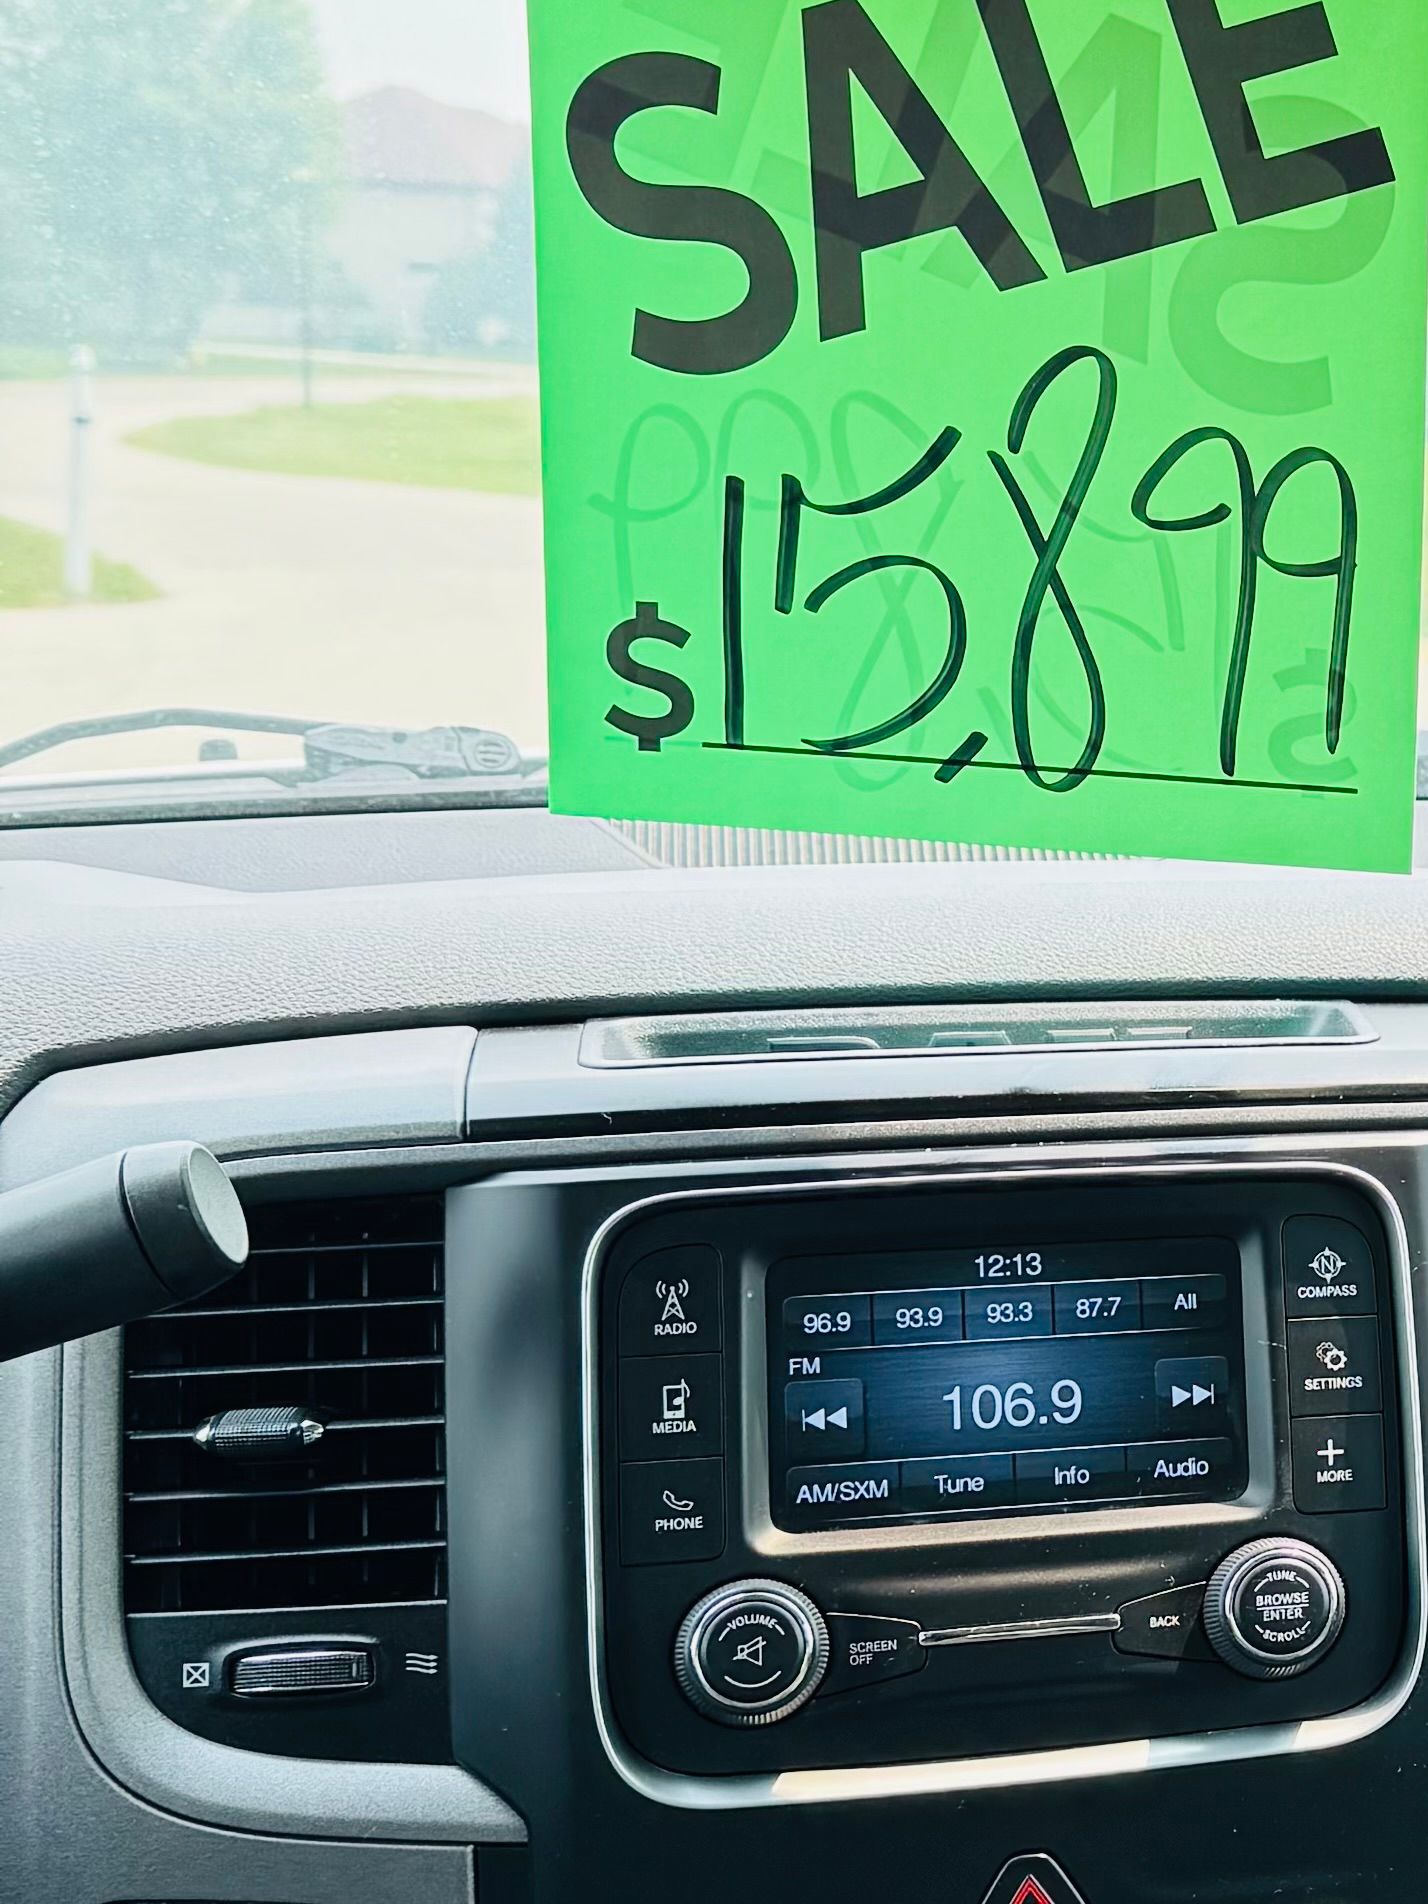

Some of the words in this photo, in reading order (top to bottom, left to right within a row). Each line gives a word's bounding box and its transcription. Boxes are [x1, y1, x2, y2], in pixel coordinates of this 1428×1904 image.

[604, 345, 1358, 793] $15,899
[975, 1253, 1041, 1277] 12:13
[1298, 1285, 1357, 1298] COMPASS
[1076, 1297, 1121, 1318] 87.7
[1175, 1293, 1197, 1310] All
[896, 1307, 942, 1328] 93.9
[987, 1302, 1032, 1323] 93.3
[655, 1322, 697, 1335] RADIO
[804, 1312, 850, 1333] 96.9
[789, 1357, 820, 1375] FM
[1305, 1376, 1362, 1390] SETTINGS
[943, 1380, 1081, 1429] 106.9
[653, 1420, 696, 1433] MEDIA
[1055, 1466, 1089, 1485] Info
[1154, 1458, 1208, 1478] Audio
[1317, 1469, 1353, 1482] MORE
[796, 1480, 888, 1503] AM/SXM
[934, 1475, 984, 1493] Tune
[655, 1516, 703, 1531] PHONE
[1266, 1570, 1297, 1582] TUNE
[1256, 1591, 1309, 1607] BROWSE
[727, 1614, 778, 1630] VOLUME
[1150, 1616, 1180, 1628] BACK
[1263, 1607, 1303, 1622] ENTER
[1262, 1627, 1306, 1642] SCROLL
[850, 1639, 897, 1653] SCREEN
[850, 1654, 872, 1665] OFF
